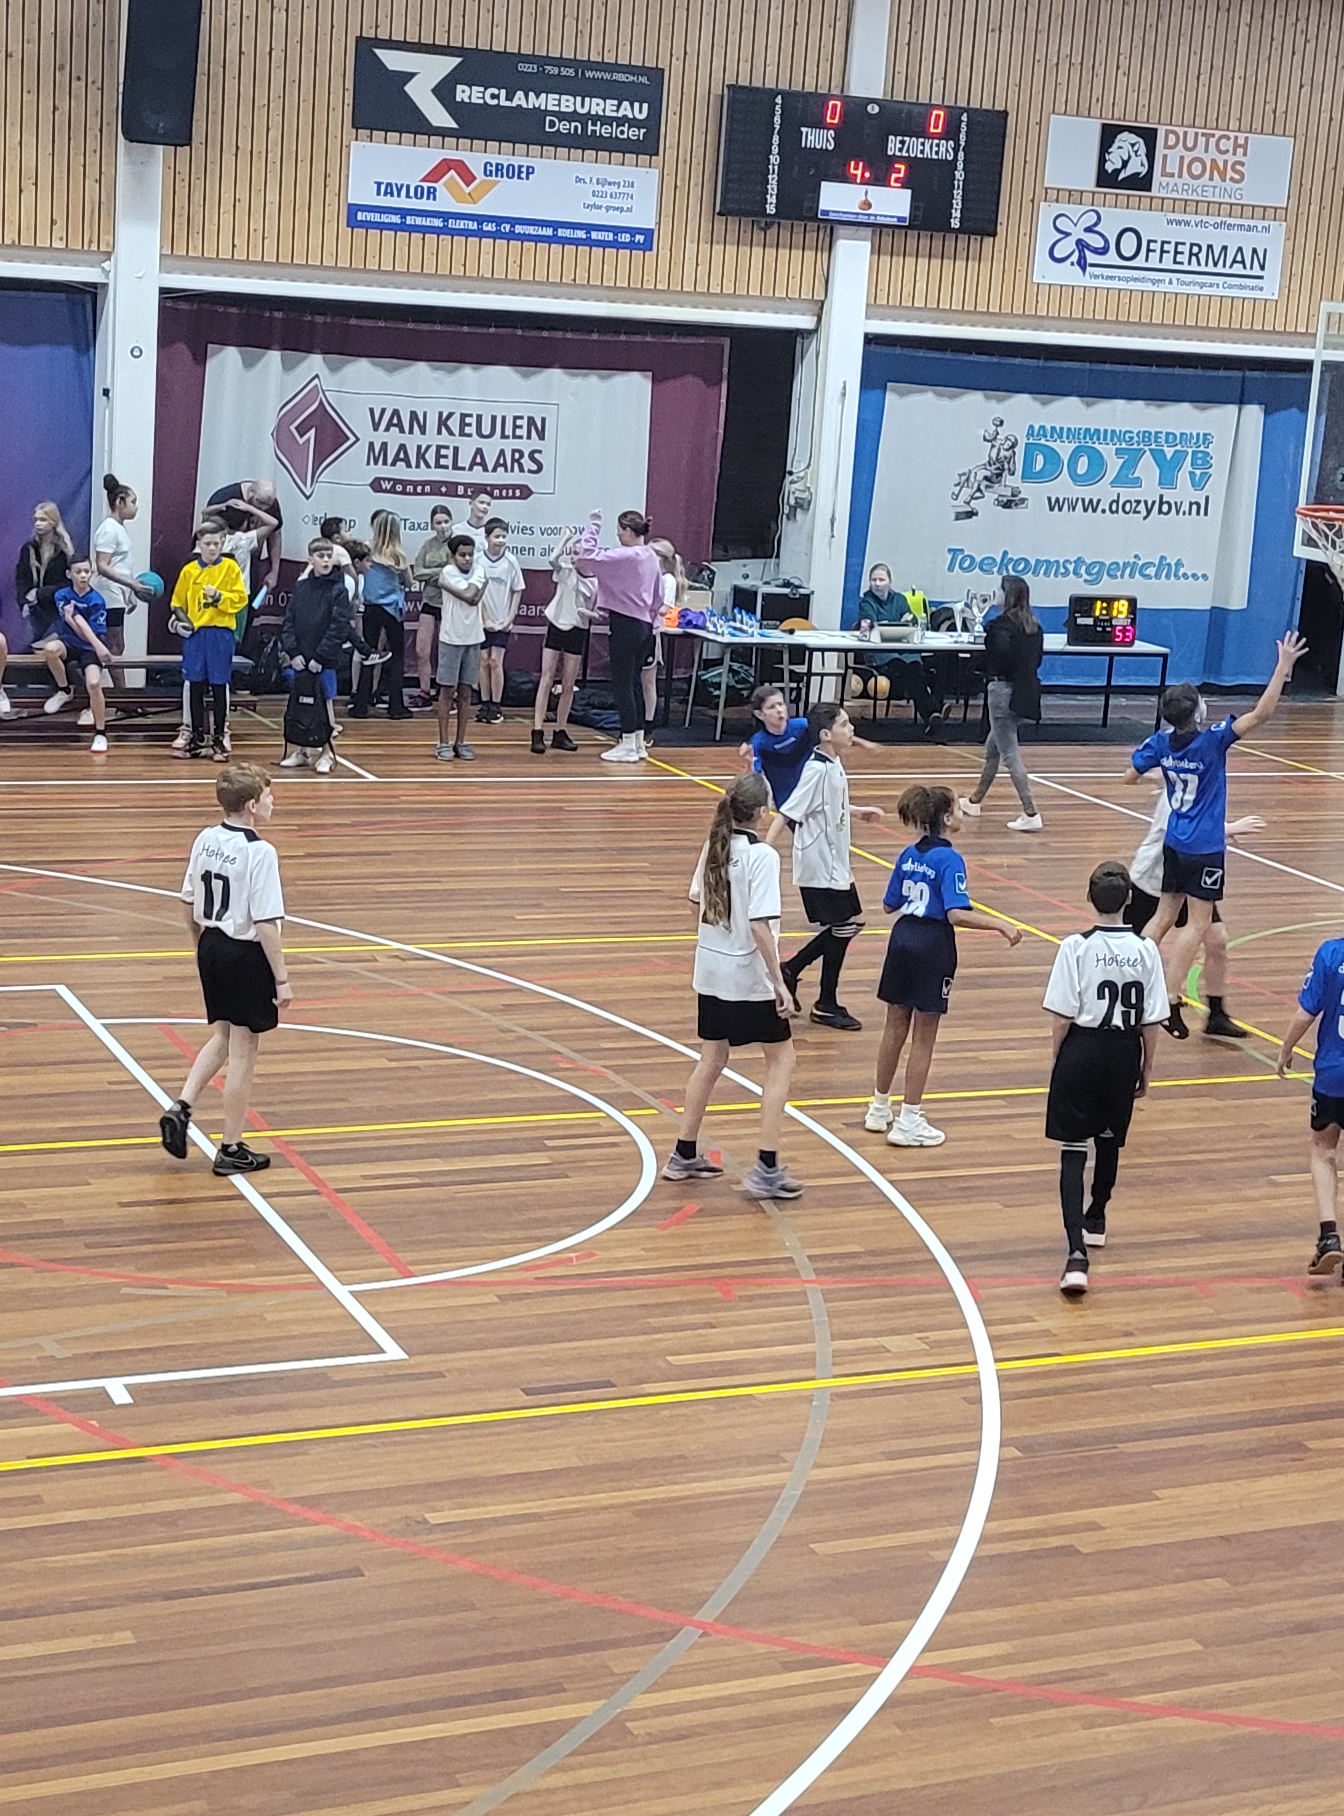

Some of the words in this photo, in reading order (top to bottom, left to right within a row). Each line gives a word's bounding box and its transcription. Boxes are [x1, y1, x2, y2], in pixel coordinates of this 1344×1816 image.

[517, 62, 538, 73] 0223
[560, 66, 576, 77] 505
[455, 84, 649, 120] RECLAMEBUREAU
[775, 95, 782, 105] 4
[774, 105, 782, 115] 5
[826, 100, 842, 125] 0
[961, 113, 968, 123] 4
[545, 116, 582, 136] Den
[587, 120, 647, 141] Helder
[773, 115, 781, 125] 6
[930, 109, 945, 134] 0
[960, 122, 967, 132] 5
[773, 125, 780, 135] 7
[800, 127, 835, 150] THUIS
[959, 132, 966, 142] 6
[772, 135, 779, 145] 8
[772, 145, 779, 154] 9
[887, 135, 955, 160] BEZOEKERS
[959, 142, 965, 151] 7
[1163, 129, 1250, 157] DUTCH
[769, 155, 780, 165] 10
[958, 151, 964, 161] 8
[483, 161, 536, 181] GROEP
[768, 165, 779, 175] 11
[890, 163, 906, 187] 2
[954, 171, 965, 180] 10
[957, 161, 963, 171] 9
[1160, 153, 1246, 184] LIONS
[373, 180, 438, 201] TAYLOR
[953, 181, 964, 190] 11
[1158, 181, 1243, 200] MARKETING
[765, 204, 776, 214] 15
[357, 211, 401, 224] BEVEILIGING
[406, 215, 444, 228] BEWAKING
[449, 218, 477, 230] ELEKTRA
[483, 222, 496, 231] GAS
[501, 223, 510, 233] CV
[515, 224, 553, 236] DUURZAAM
[558, 227, 586, 239] KOELING
[591, 230, 613, 241] WATER
[618, 232, 630, 242] LED
[635, 234, 645, 243] PV
[950, 218, 960, 228] 15
[1166, 217, 1271, 234] www.vtc-offerman.nl
[1089, 271, 1166, 287] Verkeersopleidingen
[1168, 278, 1173, 286] &
[1176, 278, 1220, 290] Touringcars
[1222, 281, 1264, 292] Combinatie
[369, 407, 427, 436] VAN
[437, 410, 547, 441] KEULEN
[1026, 424, 1214, 448] AANNEMINGSBEDRIJF
[366, 441, 544, 475] MAKELAARS
[1021, 442, 1188, 490] DOZY
[380, 480, 431, 493] Wonen
[1046, 492, 1210, 521] www.dozybv.nl
[947, 548, 1209, 585] Toekomstgericht...
[1095, 599, 1129, 618] 1:19
[1115, 626, 1135, 642] 53
[201, 869, 230, 921] 17
[1097, 979, 1144, 1029] 29
